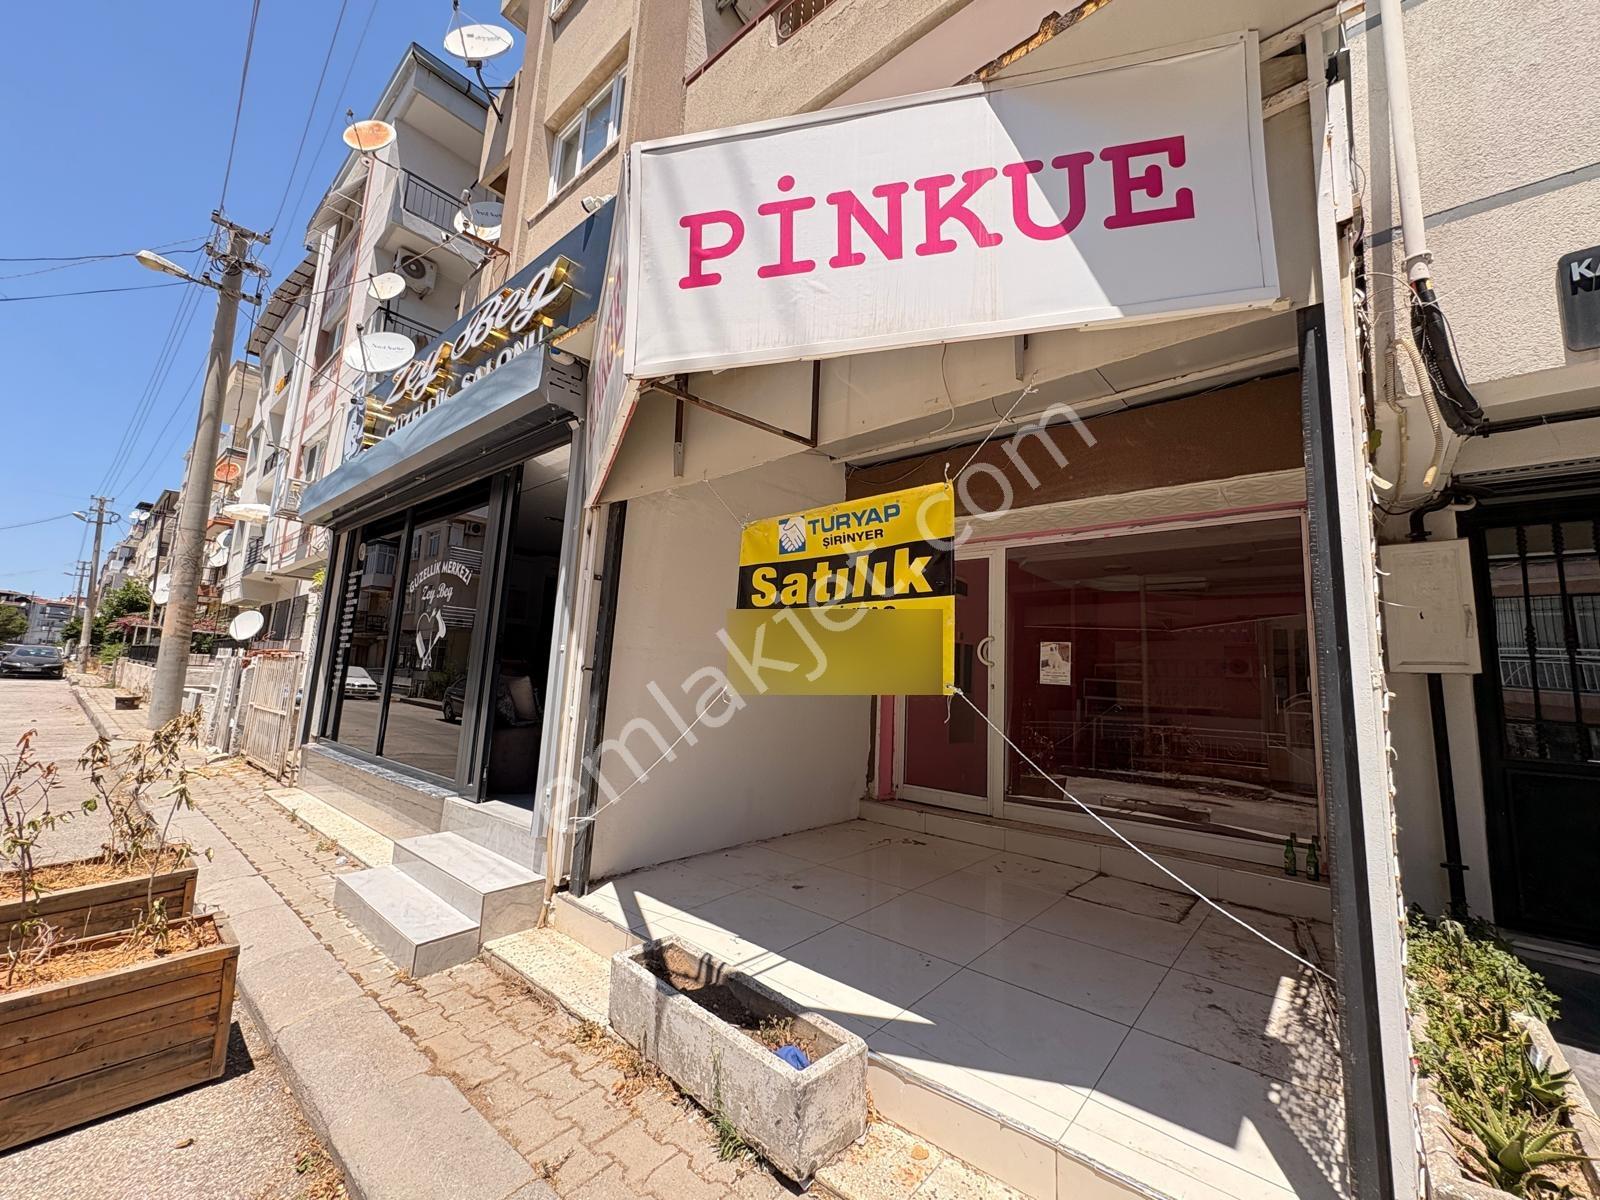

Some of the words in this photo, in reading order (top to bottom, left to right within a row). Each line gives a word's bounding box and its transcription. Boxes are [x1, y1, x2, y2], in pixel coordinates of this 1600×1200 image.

[678, 135, 1195, 290] PİNKUE
[382, 346, 445, 406] Zey
[451, 254, 565, 361] Beg
[808, 504, 901, 535] TURYAP
[822, 528, 884, 550] ŞİRİNYER
[409, 560, 442, 593] GÜZELLİK
[441, 560, 473, 586] MERKEZİ
[751, 547, 933, 608] Satılık
